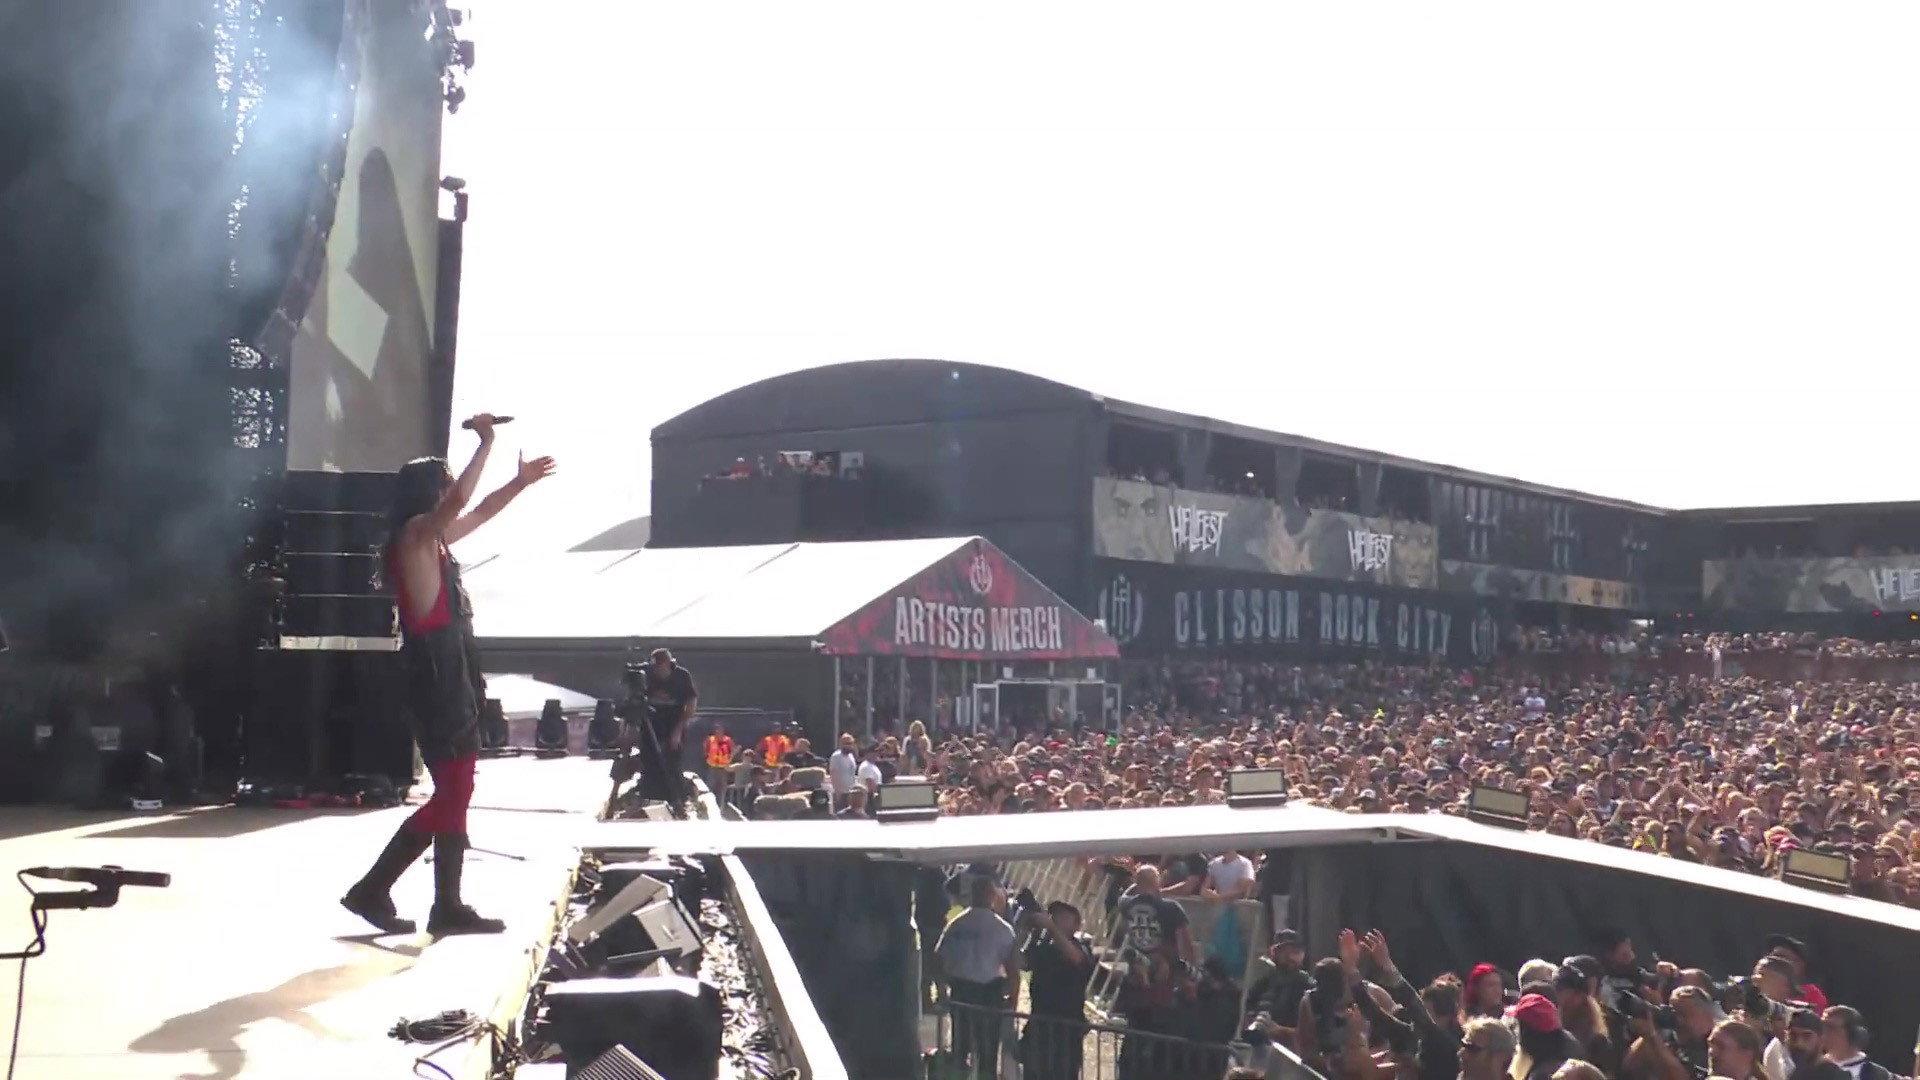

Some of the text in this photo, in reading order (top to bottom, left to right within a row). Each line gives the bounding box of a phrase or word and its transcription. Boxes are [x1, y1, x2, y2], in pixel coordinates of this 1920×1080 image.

[1168, 504, 1229, 557] HELLFEST
[1347, 529, 1393, 572] HELLFEST
[896, 596, 1062, 651] ARTISTS MERCH
[1174, 588, 1450, 656] CLISSON ROCK CITY
